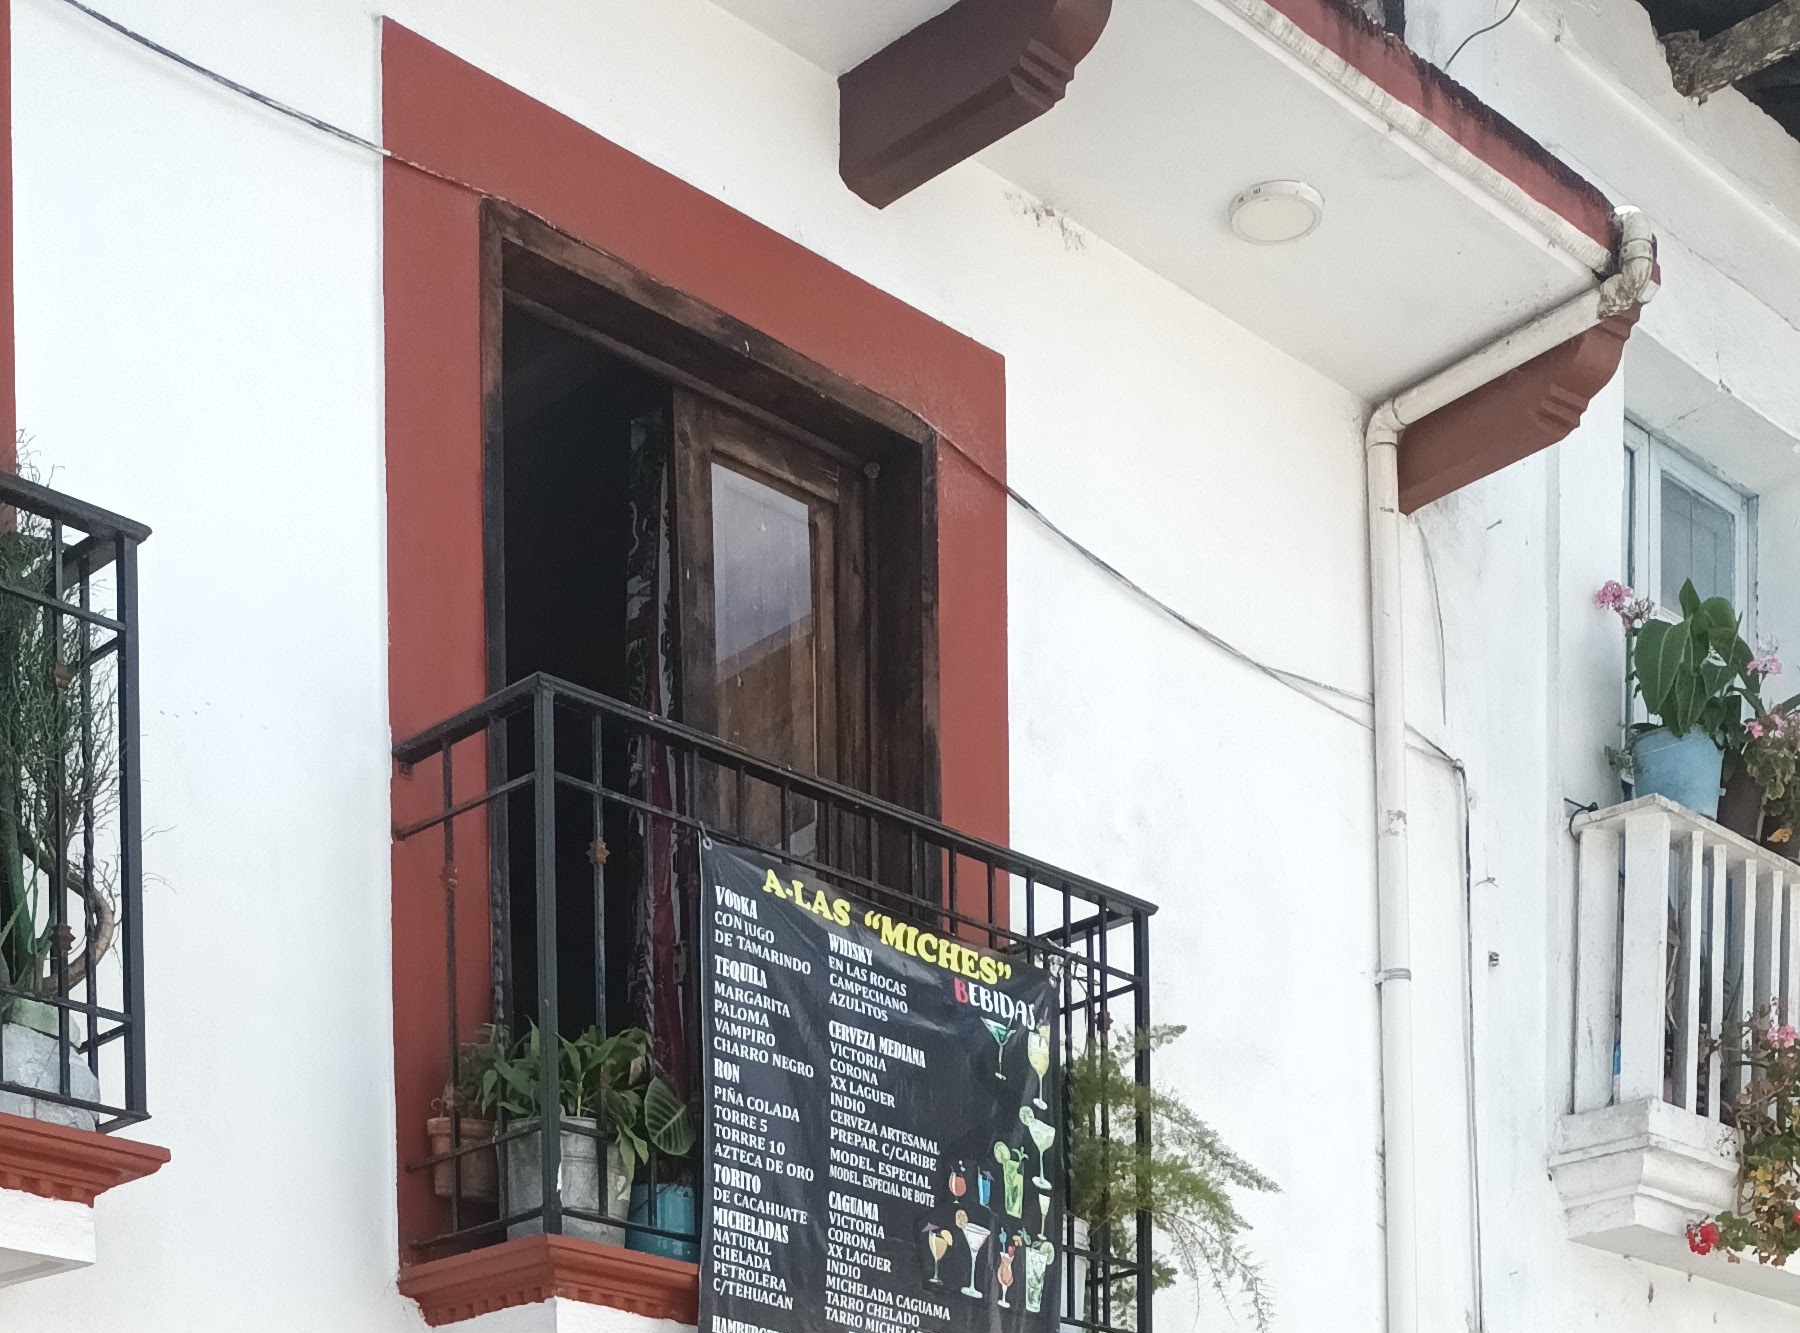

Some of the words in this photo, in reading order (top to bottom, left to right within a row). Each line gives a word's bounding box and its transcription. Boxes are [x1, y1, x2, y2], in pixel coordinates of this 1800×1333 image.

[715, 885, 757, 919] VODKA
[763, 869, 850, 926] A-LAS
[715, 911, 742, 930] CON
[744, 922, 774, 944] JUGO
[715, 929, 733, 946] DE
[737, 936, 811, 975] TAMARINDO
[828, 933, 872, 965] WHISKY
[715, 955, 767, 988] TEQUILA
[829, 955, 843, 972] EN
[846, 963, 867, 981] LAS
[870, 973, 907, 996] ROCAS
[715, 981, 790, 1017] MARGARITA
[829, 992, 888, 1022] AZULITOS
[830, 973, 908, 1014] CAMPECHANO
[954, 978, 1035, 1030] BEBIDAS
[715, 999, 769, 1027] PALOMA
[714, 1018, 775, 1047] VAMPIRO
[829, 1020, 876, 1051] CERVEZA
[879, 1036, 926, 1068] MEDIANA
[714, 1036, 768, 1063] CHARRO
[772, 1053, 814, 1077] NEGRO
[714, 1058, 740, 1083] RON
[830, 1041, 886, 1072] VICTORIA
[830, 1059, 878, 1086] CORONA
[714, 1085, 744, 1107] PIÑA
[747, 1096, 800, 1122] COLADA
[830, 1075, 846, 1092] XX
[850, 1081, 895, 1108] LAGUER
[830, 1092, 865, 1114] INDIO
[714, 1104, 756, 1129] TORRE
[760, 1120, 768, 1132] 5
[830, 1109, 878, 1135] CERVEZA
[880, 1125, 940, 1155] ARTESANAL
[714, 1123, 765, 1151] TORRRE
[769, 1141, 785, 1155] 10
[830, 1126, 879, 1153] PREPAR.
[882, 1143, 937, 1171] C/CARIBE
[714, 1143, 763, 1169] AZTECA
[766, 1157, 784, 1174] DE
[787, 1164, 814, 1182] ORO
[714, 1163, 761, 1194] TORITO
[830, 1147, 875, 1172] MODEL.
[879, 1161, 931, 1189] ESPECIAL
[714, 1187, 730, 1204] DE
[734, 1192, 808, 1225] CACAHUATE
[829, 1191, 879, 1222] CAGUAMA
[863, 1174, 900, 1197] ESPECIAL
[902, 1186, 913, 1201] DE
[914, 1189, 935, 1207] BOTE
[713, 1206, 789, 1244] MICHELADAS
[713, 1228, 772, 1255] NATURAL
[828, 1228, 876, 1252] CORONA
[829, 1211, 885, 1239] VICTORIA
[713, 1244, 771, 1271] CHELADA
[827, 1259, 861, 1280] INDIO
[828, 1243, 843, 1259] XX
[846, 1248, 891, 1273] LAGUER
[714, 1261, 787, 1292] PETROLERA
[713, 1278, 793, 1310] C/TEHUACAN
[826, 1275, 893, 1305] MICHELADA
[896, 1294, 950, 1321] CAGUAMA
[826, 1291, 864, 1312] TARRO
[866, 1303, 920, 1327] CHELADO
[825, 1306, 863, 1328] TARRO
